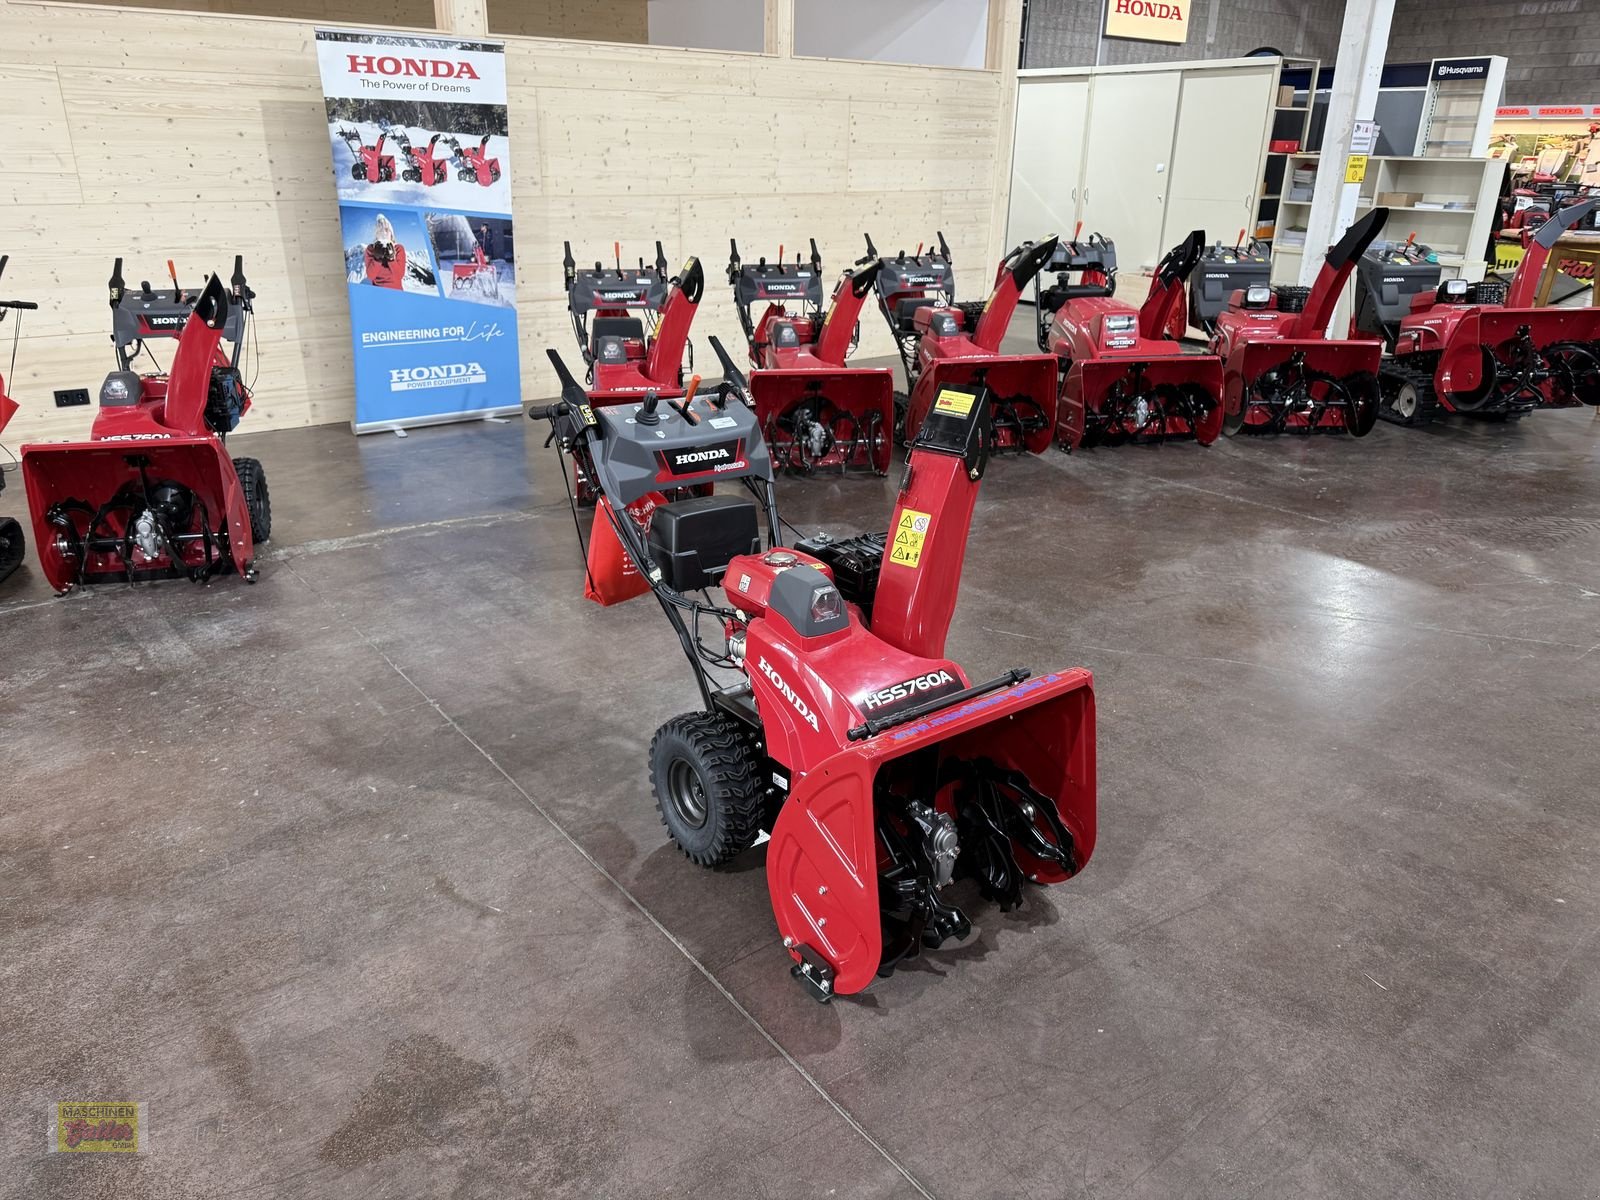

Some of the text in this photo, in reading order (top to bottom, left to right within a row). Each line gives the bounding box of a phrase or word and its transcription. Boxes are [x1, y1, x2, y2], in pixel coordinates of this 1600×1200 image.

[1115, 0, 1183, 21] HONDA
[346, 54, 481, 80] HONDA
[1446, 66, 1484, 75] Husqvarna
[360, 79, 472, 94] The Power of Dreams
[362, 320, 505, 344] ENGINEERING FOR Life
[389, 362, 486, 383] HONDA
[407, 376, 472, 389] POWER EQUIPMENT
[675, 448, 730, 465] HONDA
[758, 655, 820, 733] HONDA
[862, 670, 954, 711] HSS760A
